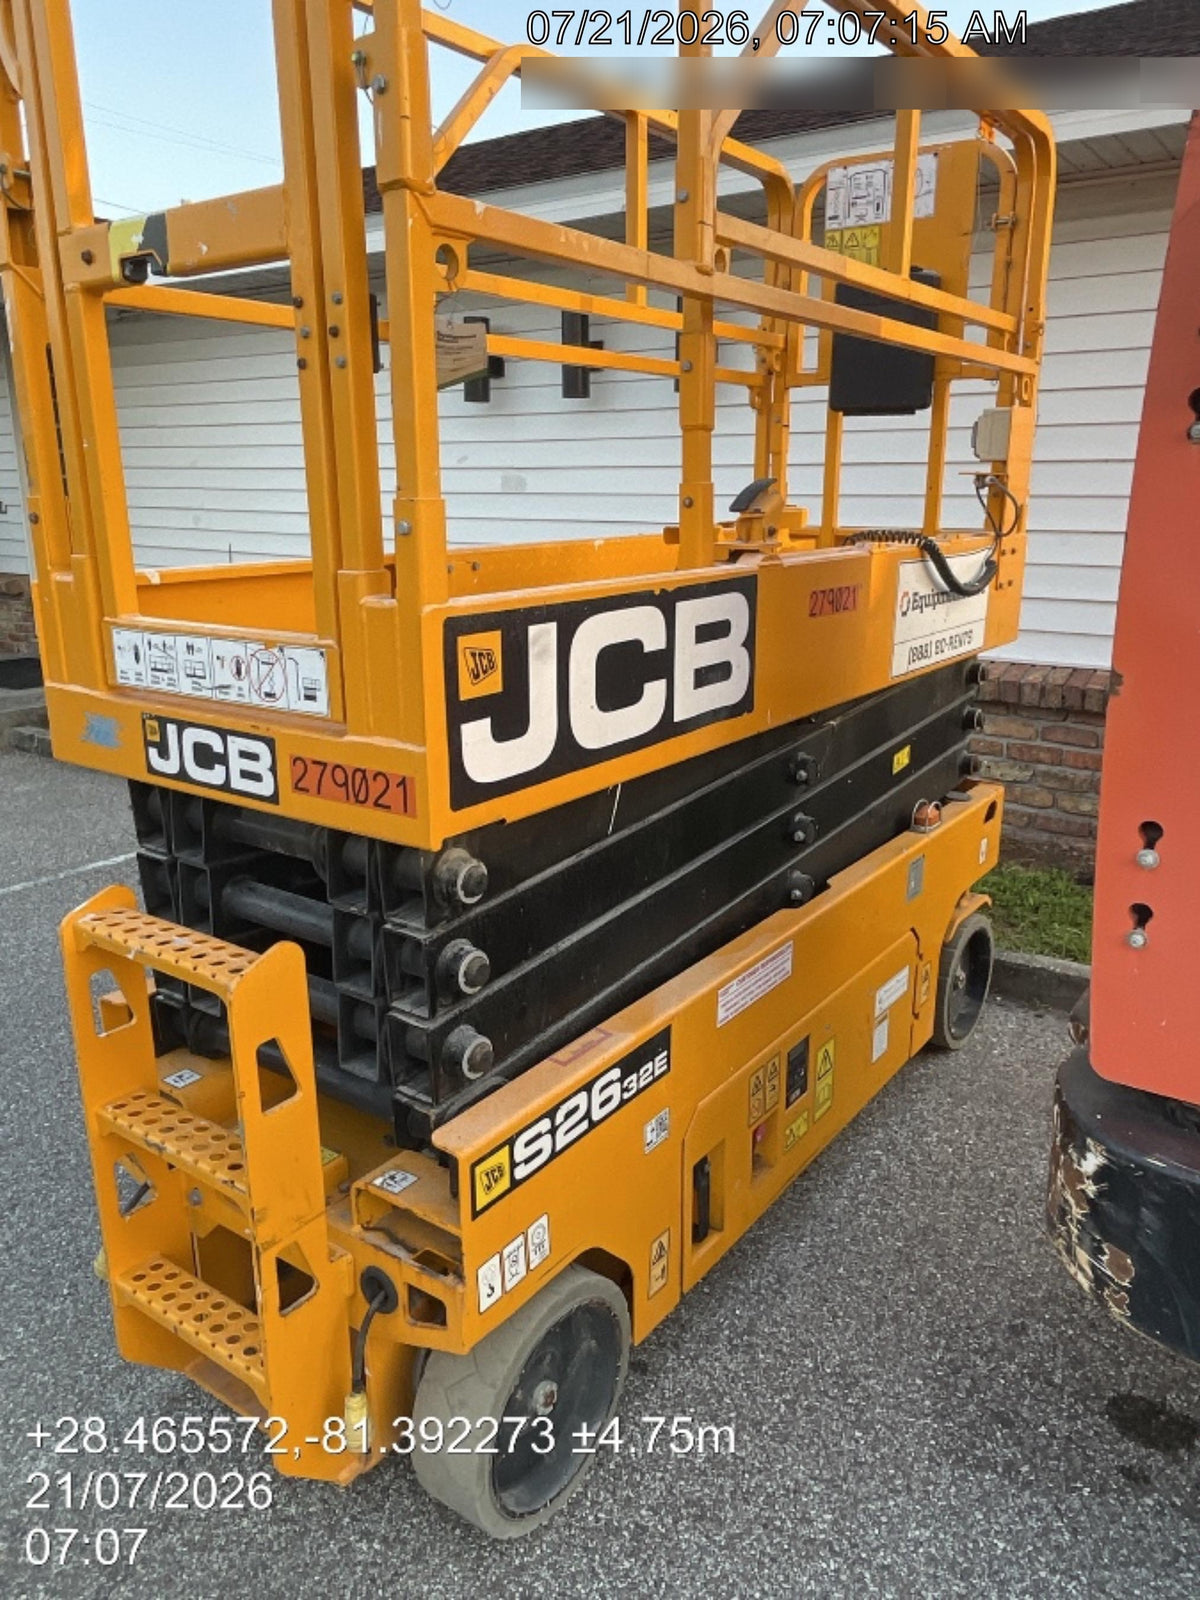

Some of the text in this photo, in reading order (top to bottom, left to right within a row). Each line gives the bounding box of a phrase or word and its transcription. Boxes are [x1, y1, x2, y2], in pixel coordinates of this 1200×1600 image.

[808, 586, 857, 618] 279021
[460, 591, 750, 784] JCB
[470, 651, 495, 680] JCB
[147, 722, 275, 798] JCB
[292, 755, 408, 814] 279021
[484, 1164, 504, 1192] JCB
